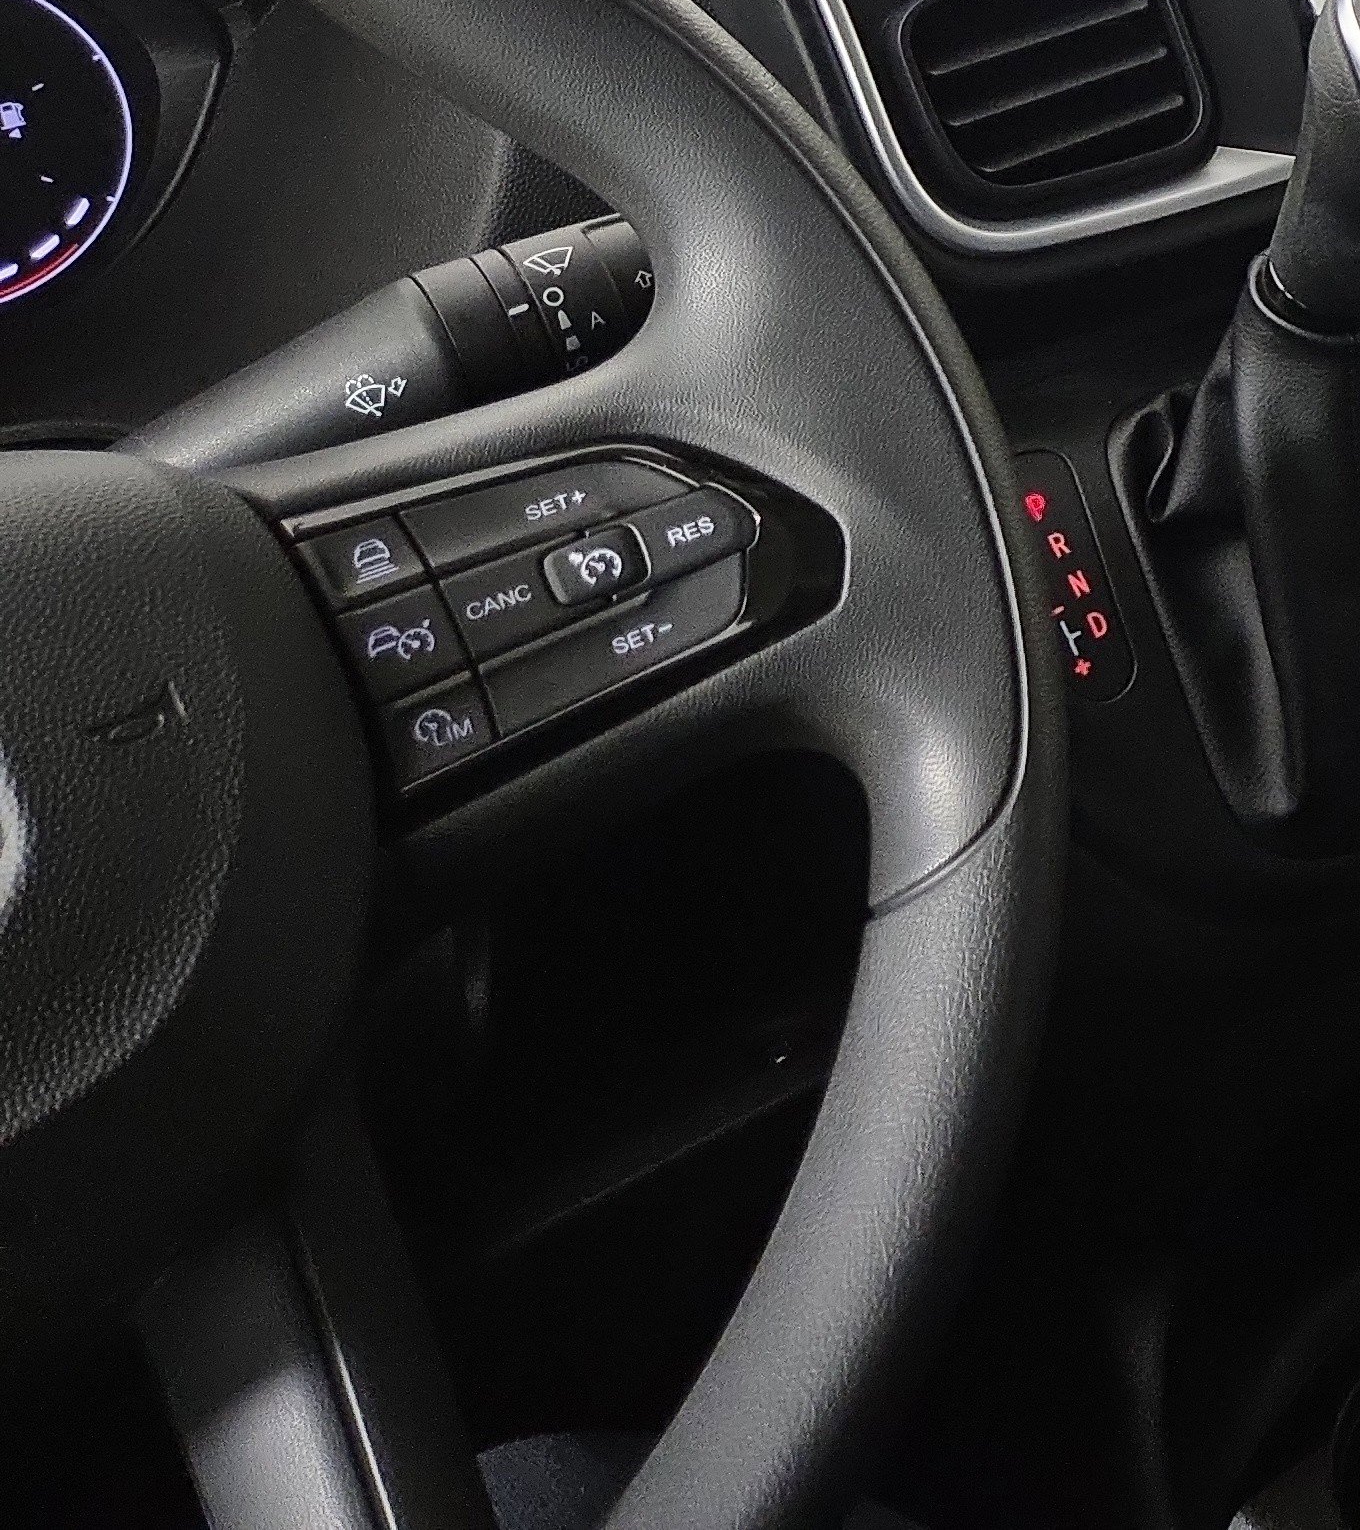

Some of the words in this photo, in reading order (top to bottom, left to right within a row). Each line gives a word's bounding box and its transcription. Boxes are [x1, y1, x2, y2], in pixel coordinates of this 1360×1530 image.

[667, 516, 715, 547] RES
[1047, 531, 1072, 559] R
[1067, 569, 1091, 599] N
[466, 584, 532, 620] CANC
[1086, 611, 1108, 639] D
